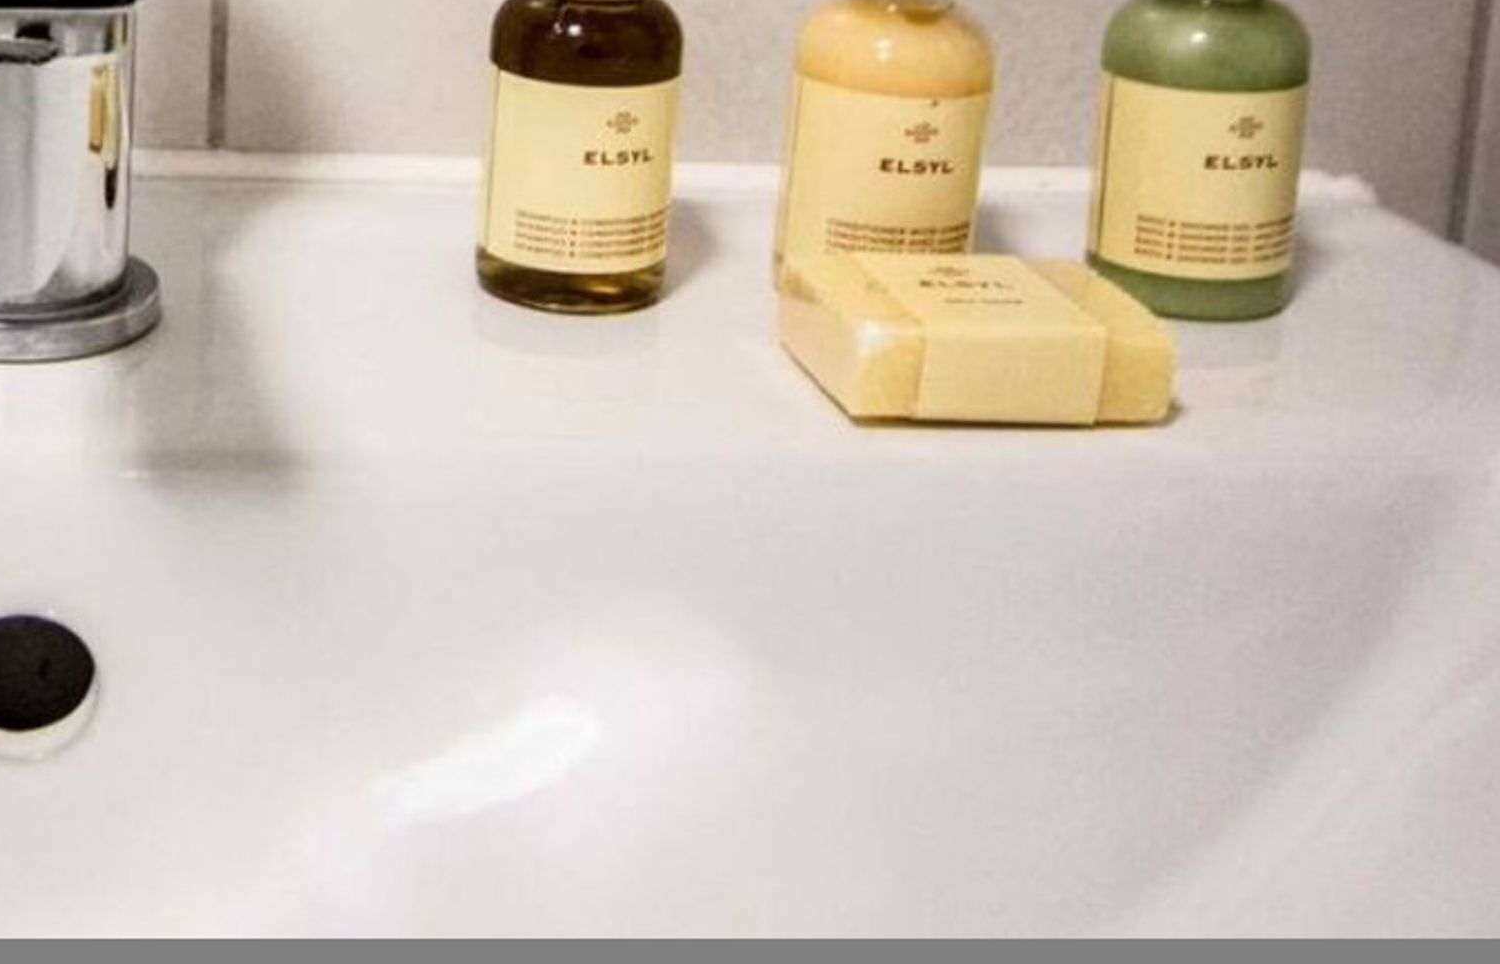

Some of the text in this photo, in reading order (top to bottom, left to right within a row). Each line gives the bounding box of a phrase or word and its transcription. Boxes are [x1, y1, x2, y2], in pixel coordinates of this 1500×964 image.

[584, 150, 653, 165] ELSYL
[1204, 155, 1278, 170] ELSYL
[880, 158, 954, 173] ELSYL
